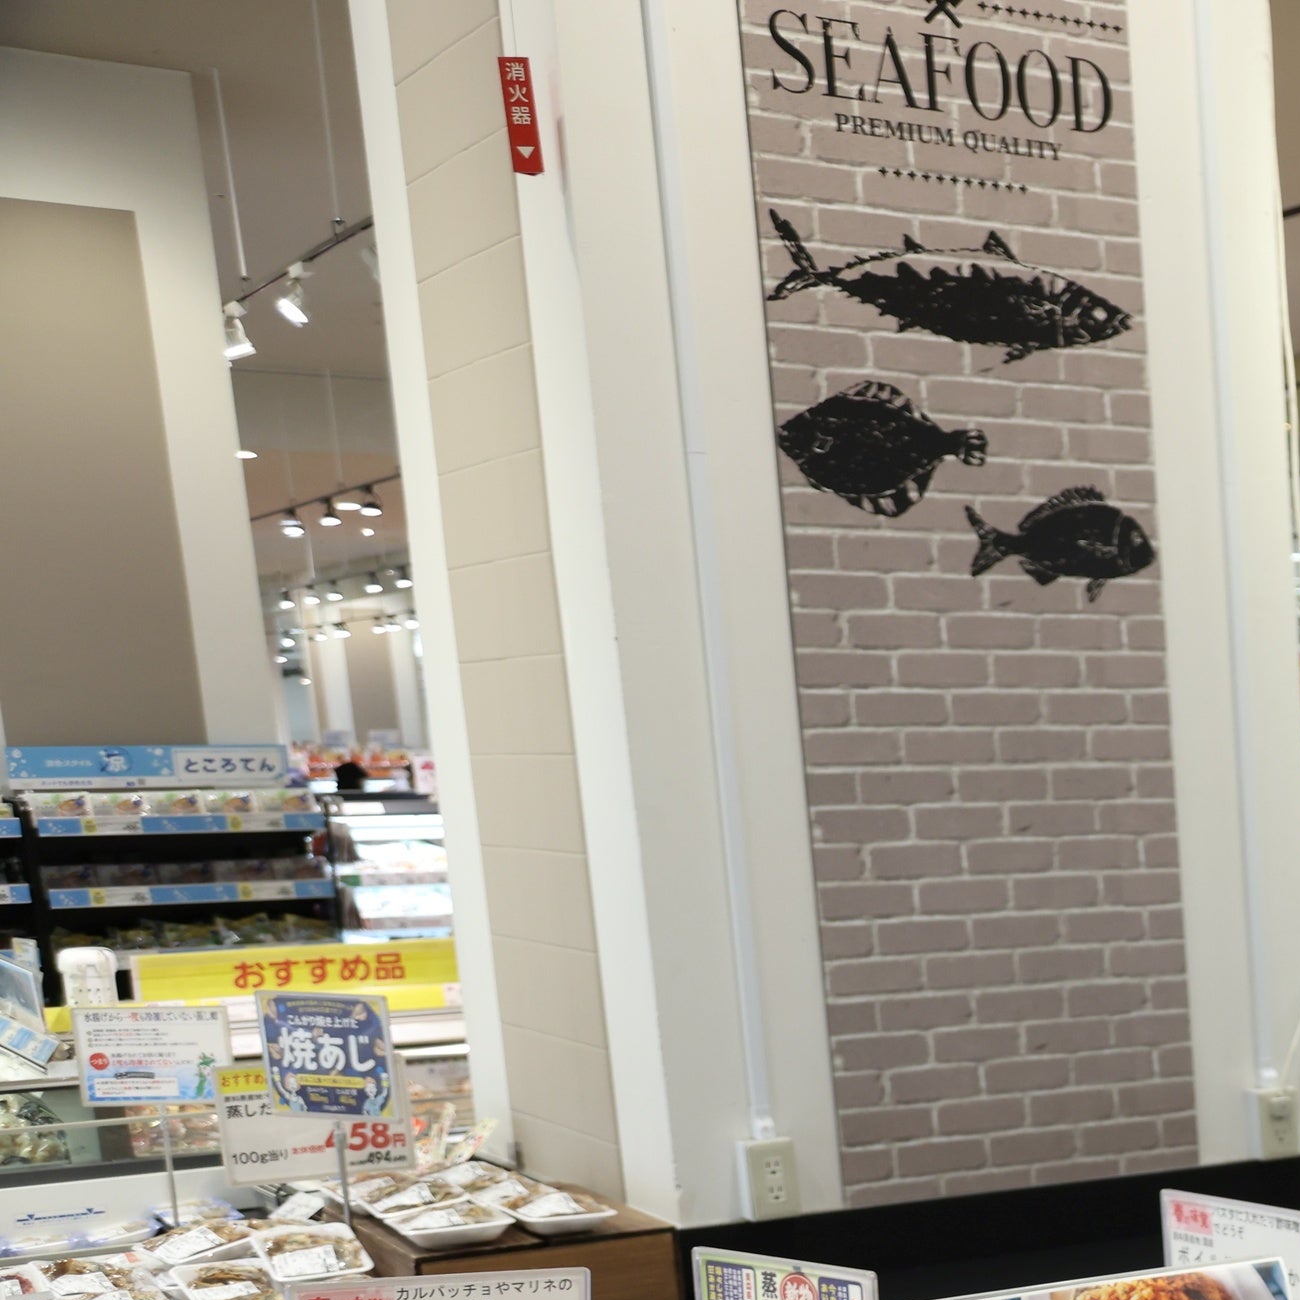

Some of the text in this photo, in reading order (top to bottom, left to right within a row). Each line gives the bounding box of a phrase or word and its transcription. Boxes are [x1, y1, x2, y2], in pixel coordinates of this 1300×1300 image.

[768, 9, 1113, 133] SEAFOOD
[505, 62, 531, 125] 消火器
[835, 113, 1062, 161] PREMIUM QUALITY
[184, 757, 277, 774] ところてん
[233, 953, 406, 988] おすすめ品
[278, 1026, 376, 1072] 焼あじ
[221, 1072, 268, 1088] おすすめ
[232, 1149, 288, 1166] 100g当り
